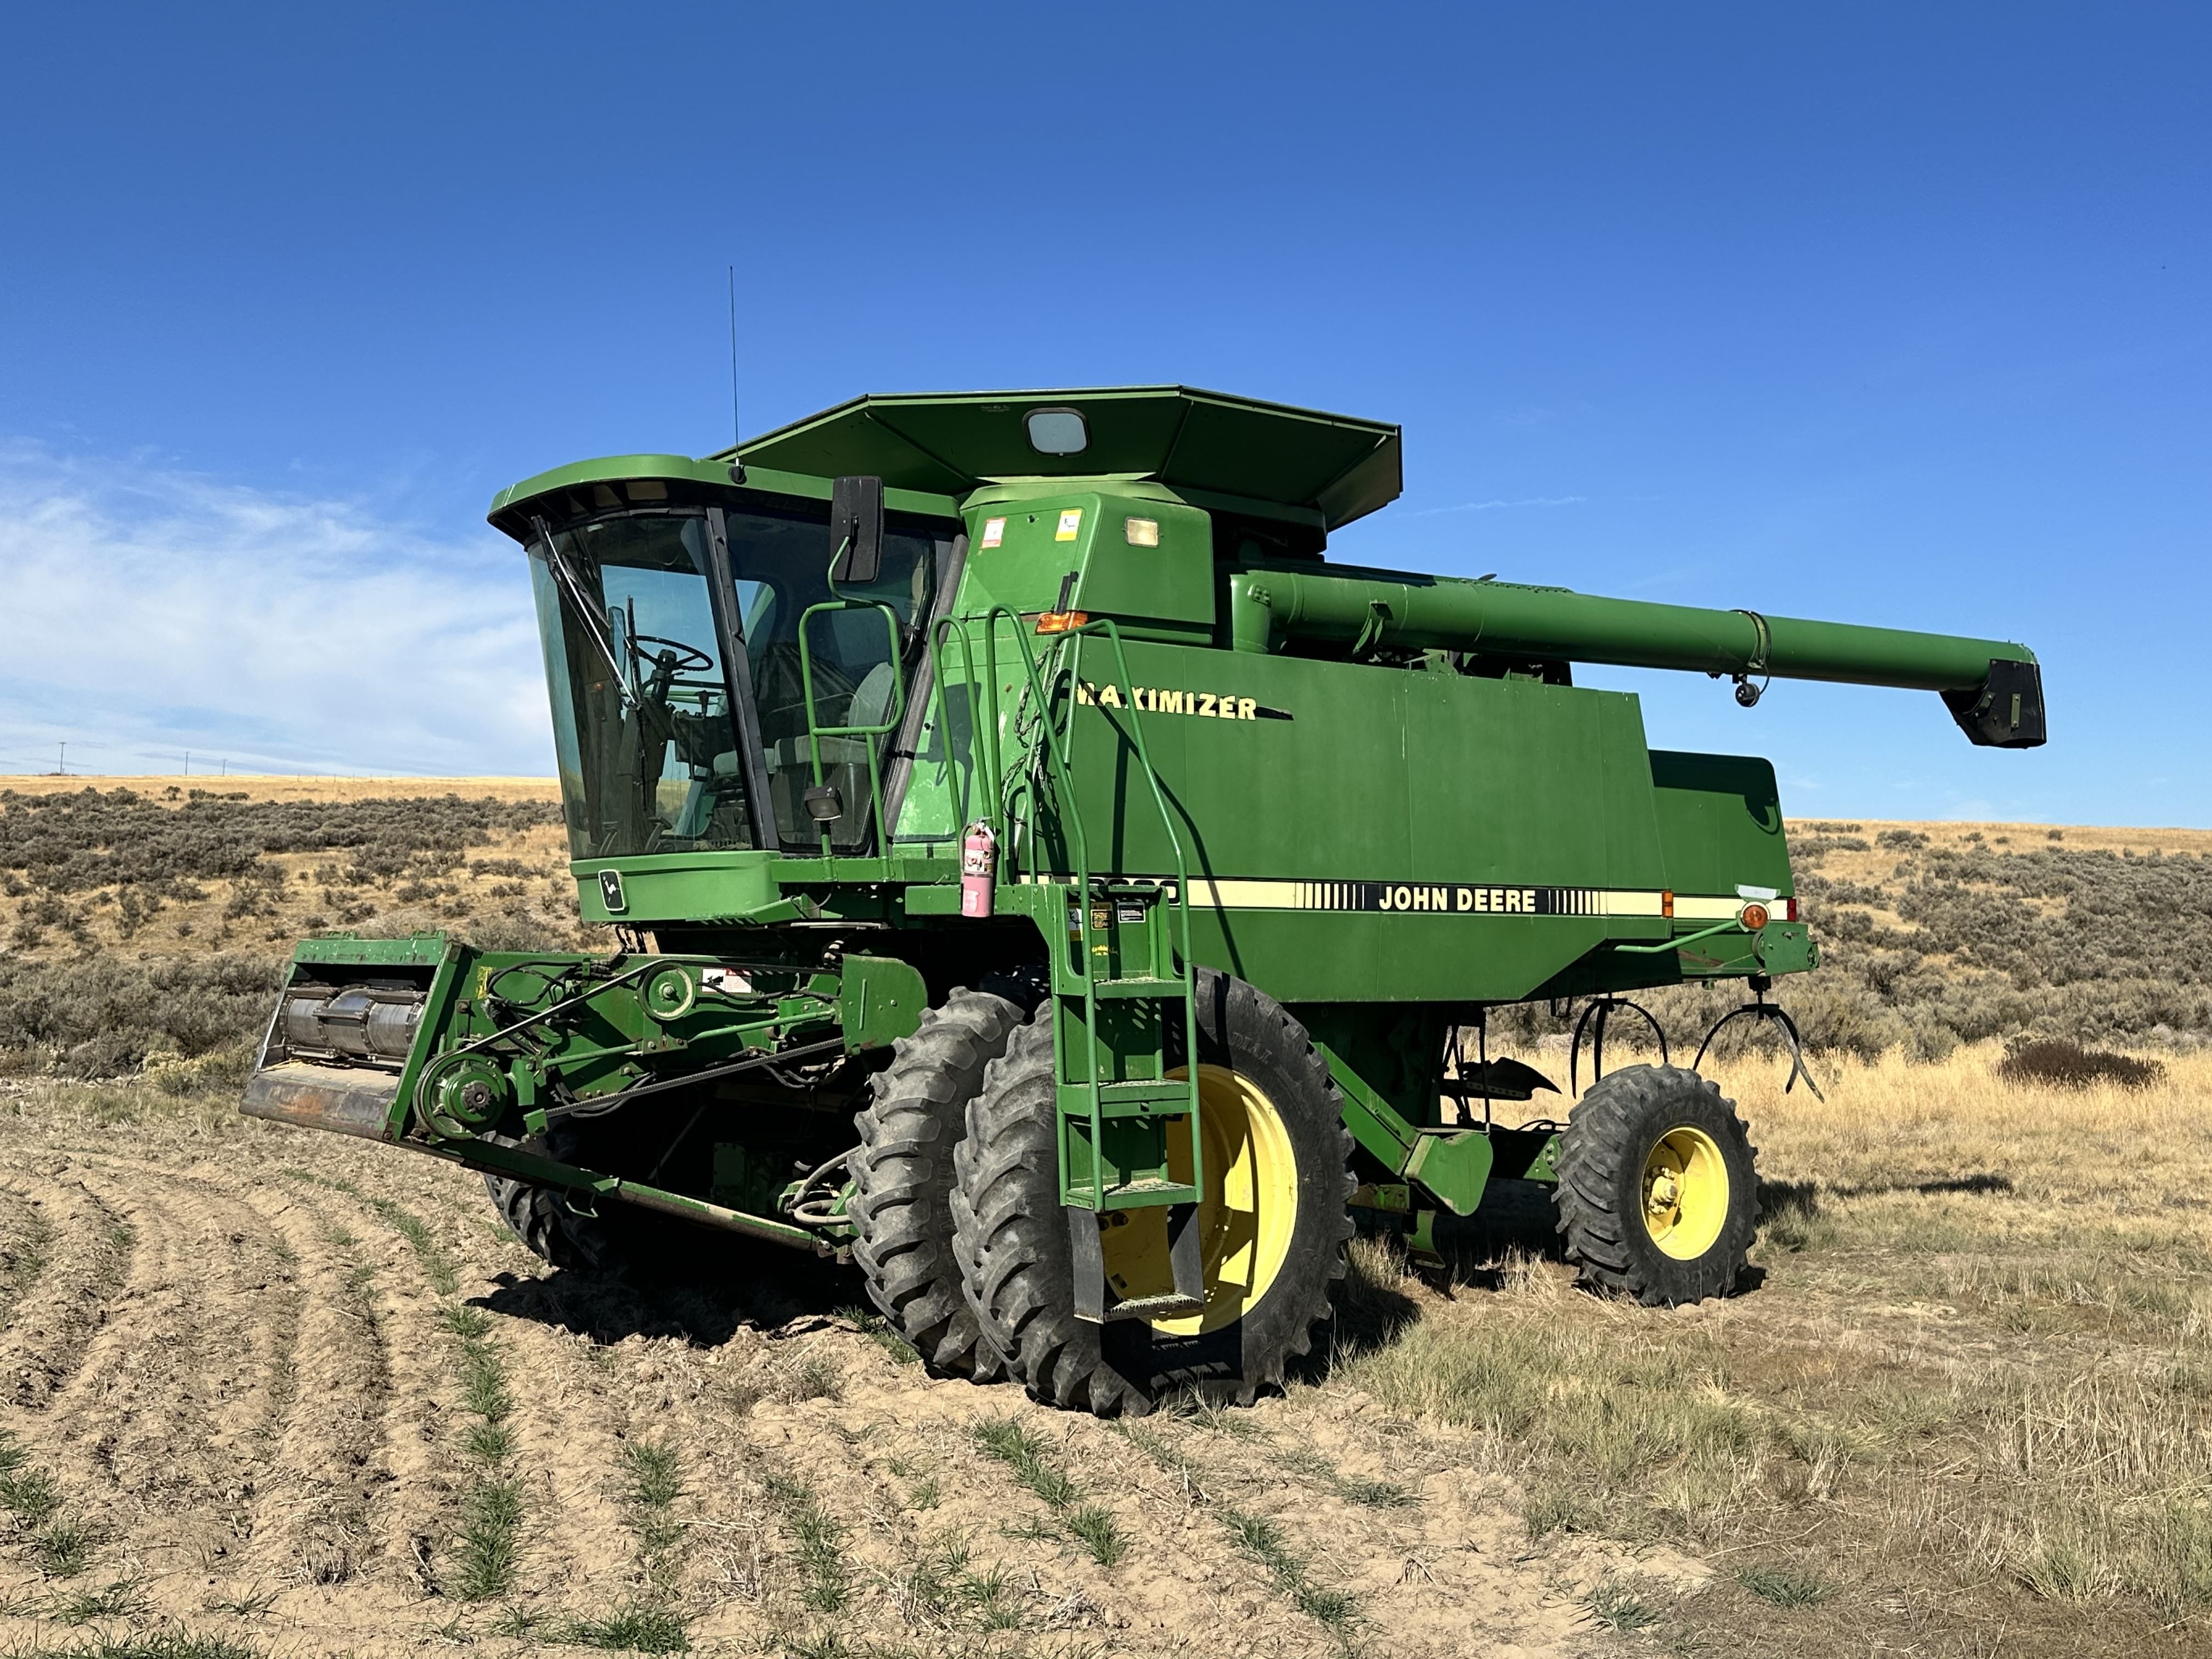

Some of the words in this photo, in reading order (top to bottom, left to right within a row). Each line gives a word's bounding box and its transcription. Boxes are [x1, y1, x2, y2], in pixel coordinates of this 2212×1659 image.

[1077, 682, 1257, 720] MAXIMIZER
[1379, 886, 1447, 910] JOHN
[1457, 888, 1536, 912] DEERE
